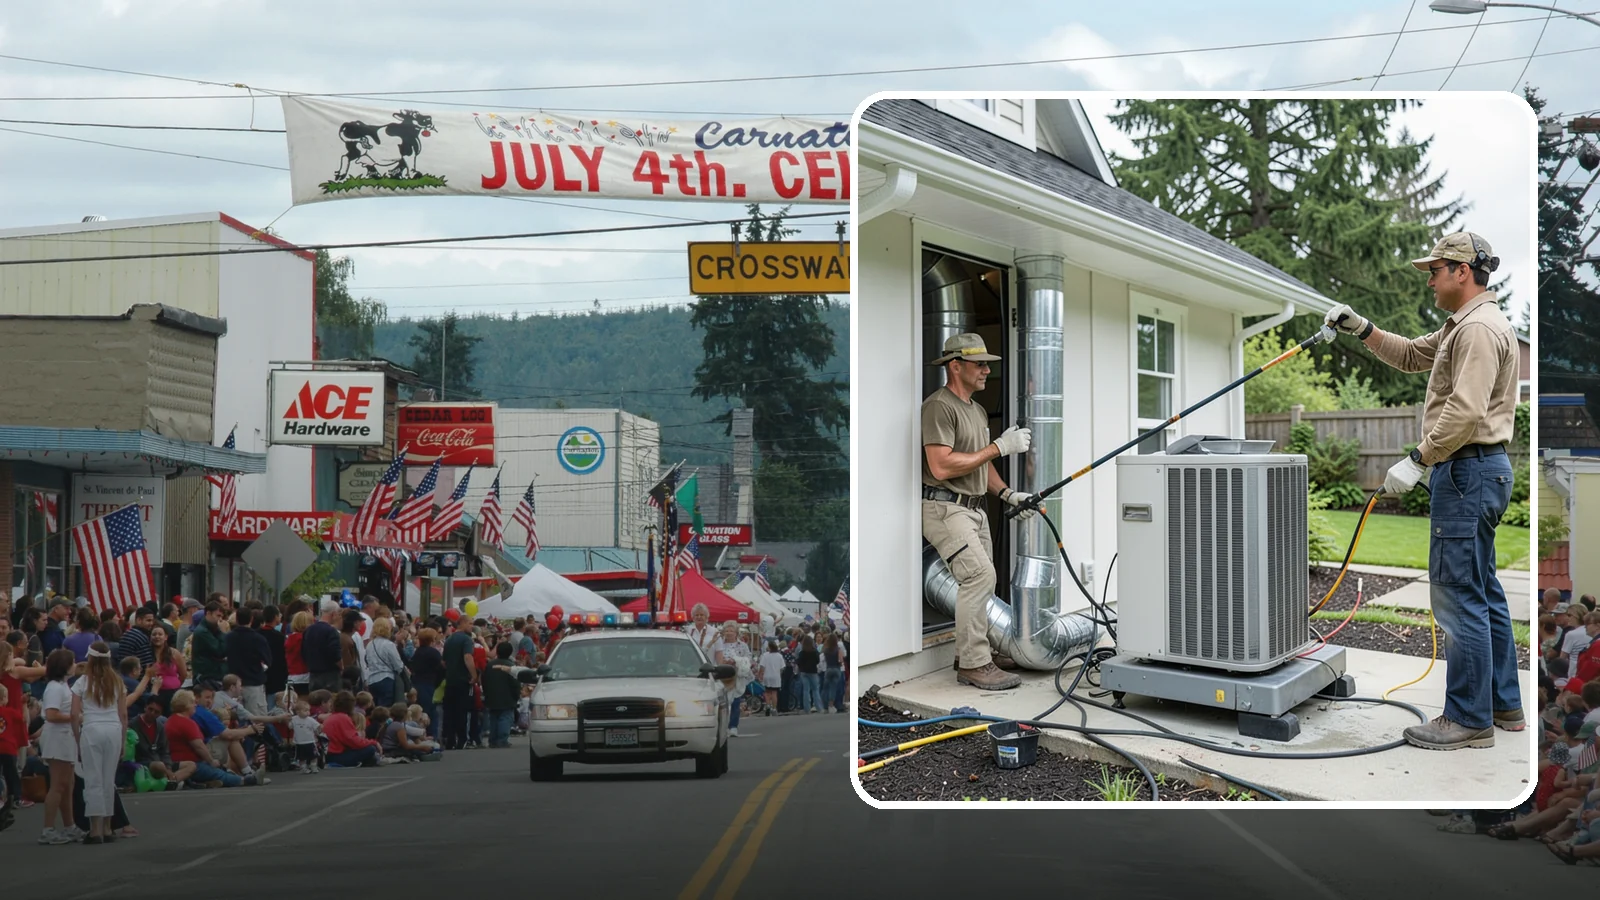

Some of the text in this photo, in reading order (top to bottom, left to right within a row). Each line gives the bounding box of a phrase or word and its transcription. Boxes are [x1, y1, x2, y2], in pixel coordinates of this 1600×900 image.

[481, 141, 605, 192] JULY
[632, 150, 746, 197] 4th.
[697, 254, 850, 280] CROSSWA
[282, 380, 374, 420] ACE
[406, 409, 485, 422] CEDAR LOG
[283, 421, 371, 436] Hardware
[416, 428, 477, 447] Coca-Cola
[83, 485, 155, 495] St. Vincent de Paul
[688, 527, 741, 535] CRNATION
[699, 535, 730, 543] GLASS
